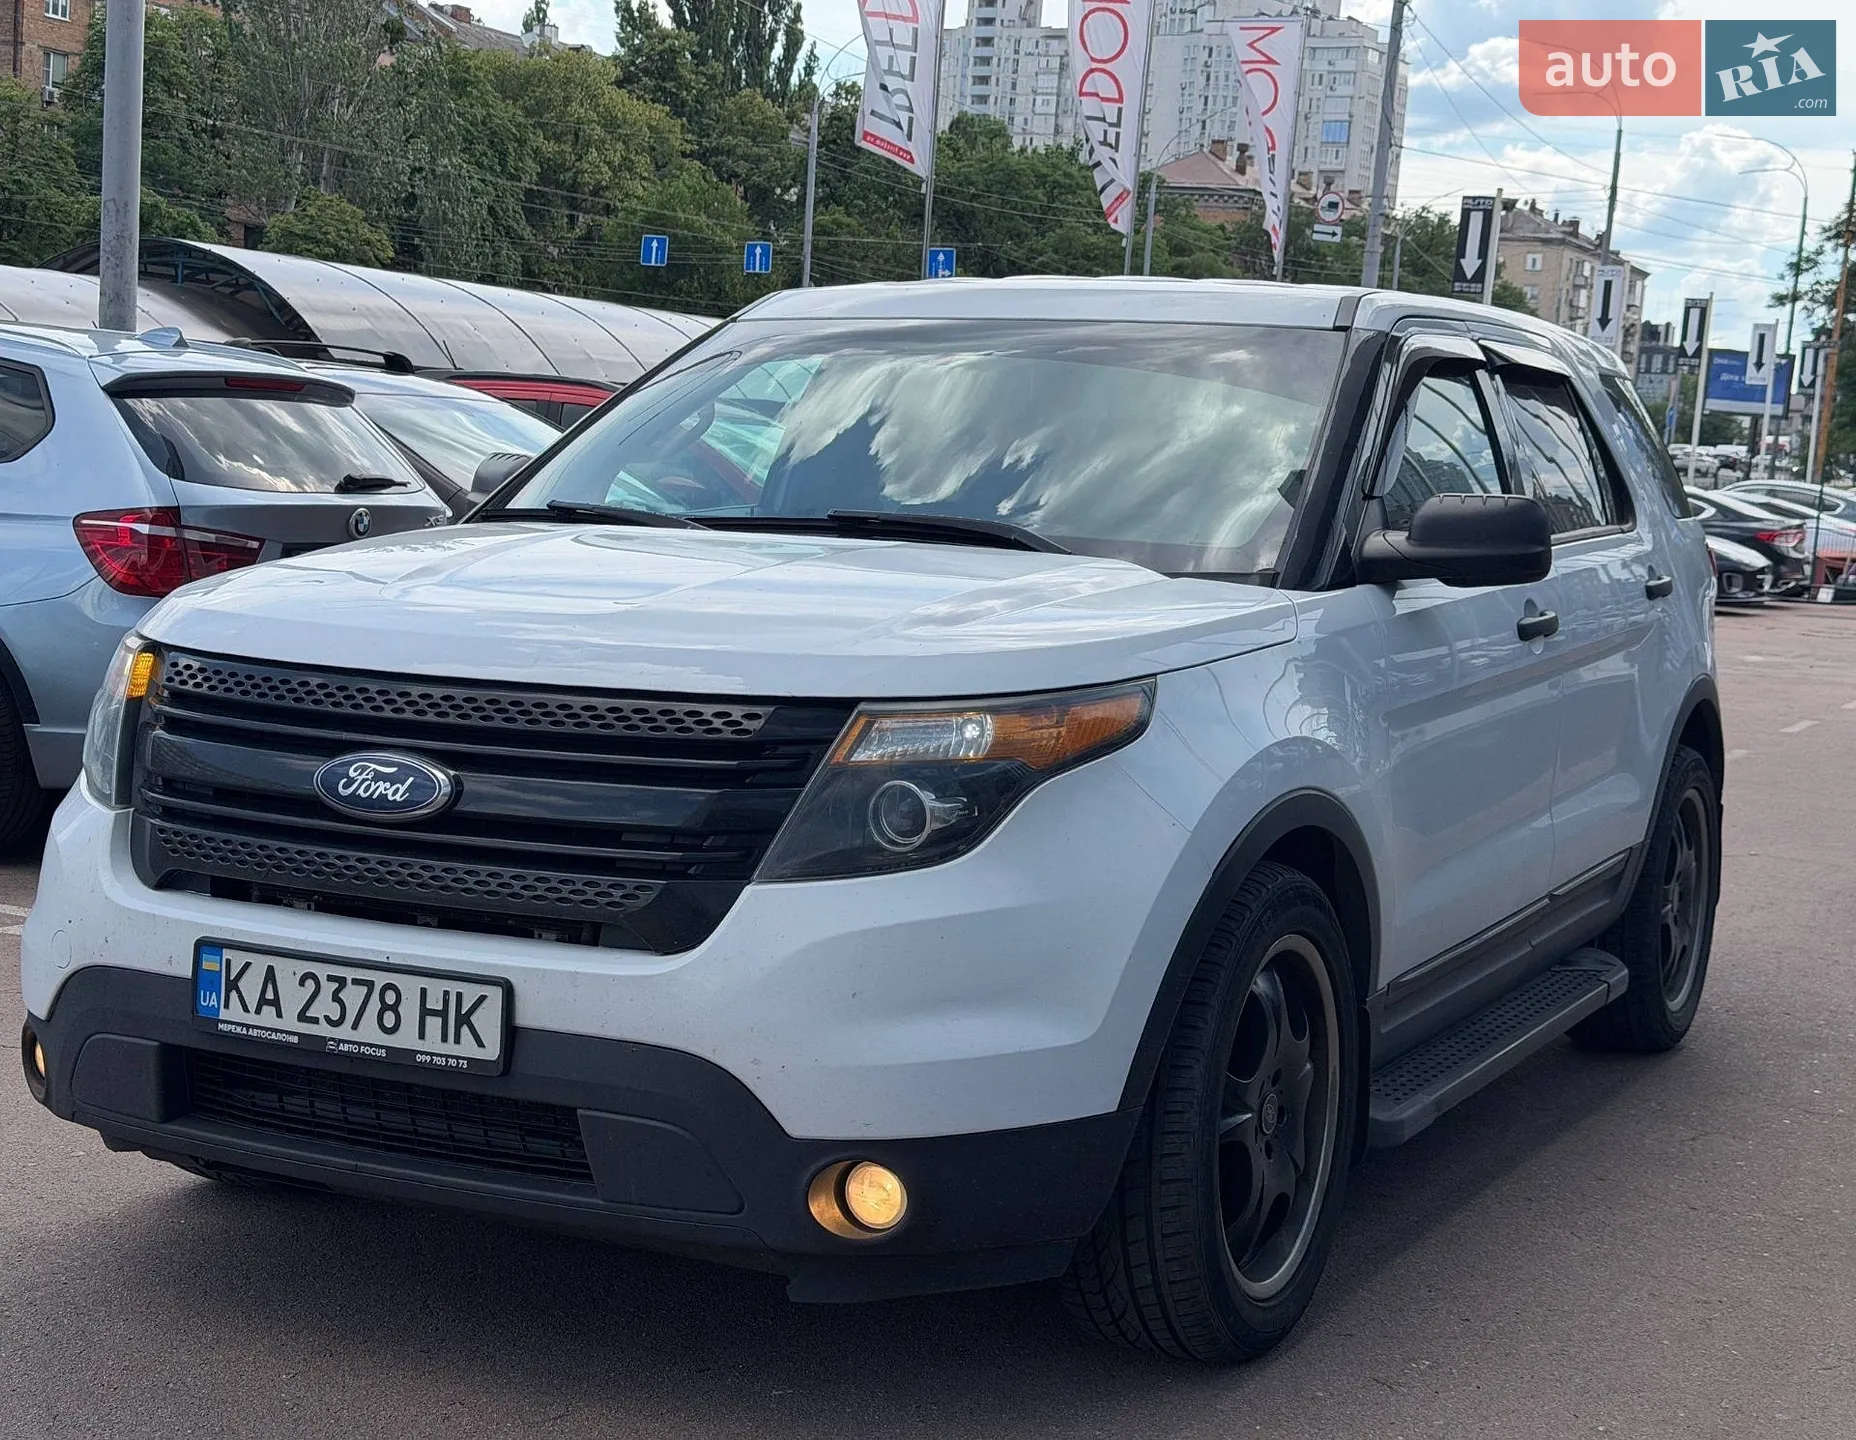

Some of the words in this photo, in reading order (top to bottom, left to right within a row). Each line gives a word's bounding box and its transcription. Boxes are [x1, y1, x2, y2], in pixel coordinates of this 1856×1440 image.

[338, 762, 414, 802] Ford
[200, 990, 218, 1008] UA
[223, 958, 284, 1019] KA
[296, 971, 402, 1035] 2378
[418, 986, 488, 1049] HK
[218, 1022, 248, 1035] МЕРЕЖА
[248, 1027, 299, 1044] АВТОСАЛОНІВ
[338, 1043, 359, 1054] АВТО
[360, 1046, 387, 1057] FOCUS
[416, 1053, 431, 1063] 099
[432, 1056, 446, 1066] 703
[447, 1058, 457, 1067] 70
[458, 1060, 468, 1068] 73
